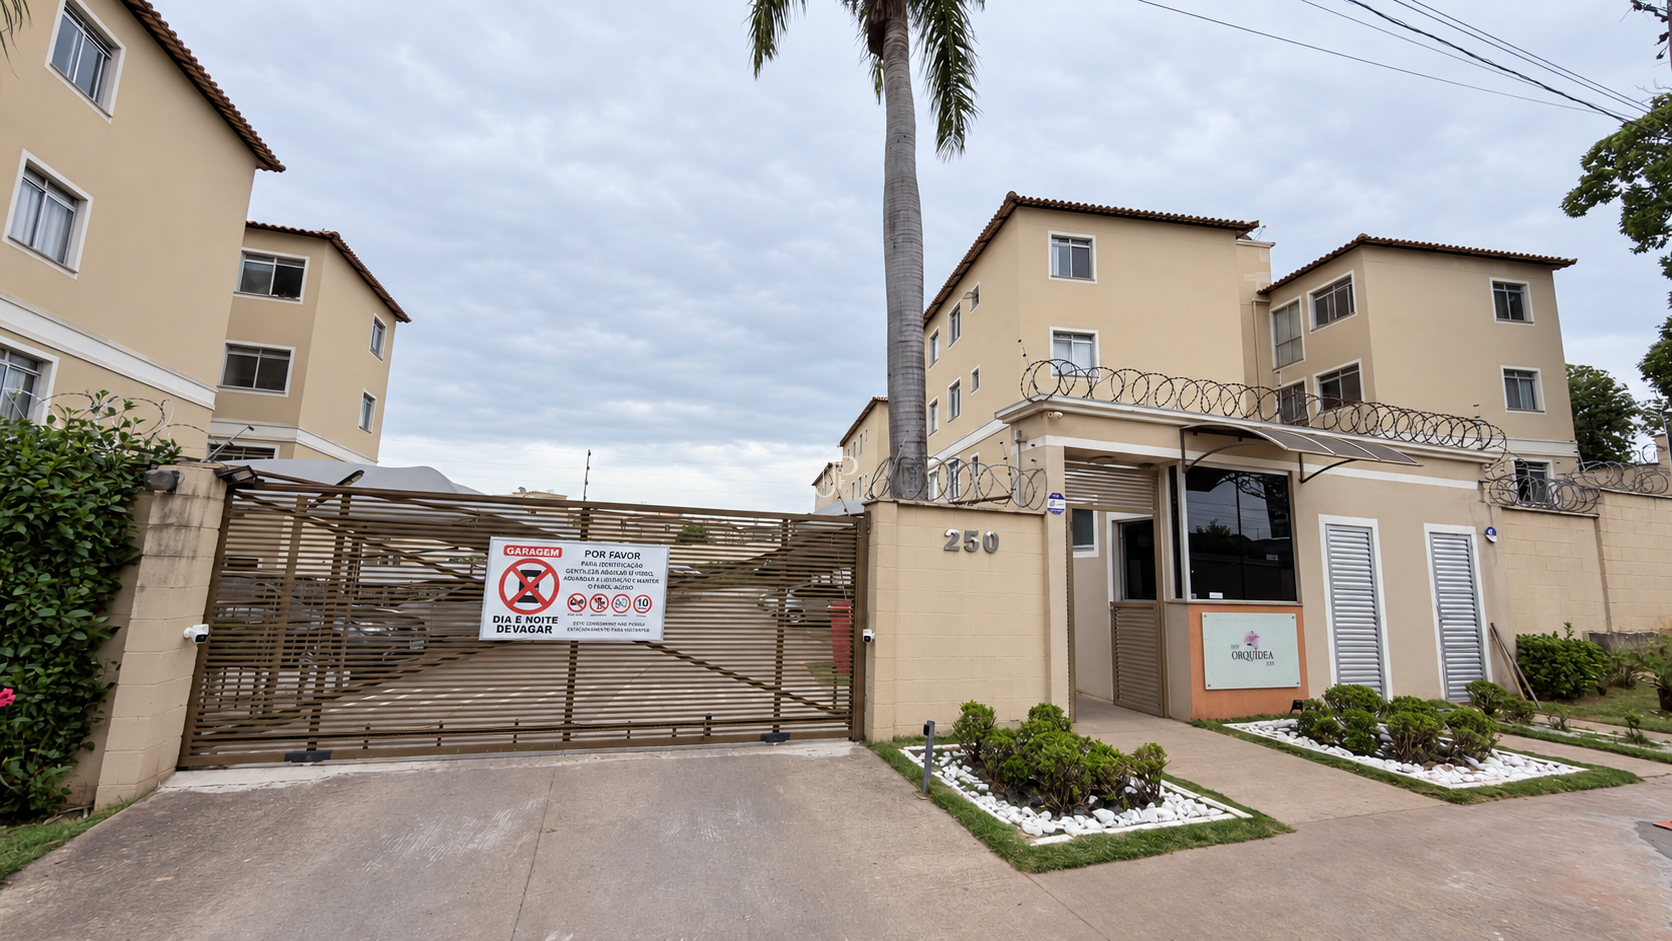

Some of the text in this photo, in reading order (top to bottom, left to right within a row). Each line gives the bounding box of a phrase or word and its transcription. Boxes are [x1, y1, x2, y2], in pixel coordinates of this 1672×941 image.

[944, 528, 1000, 553] 250
[506, 547, 560, 556] GARAGEM
[584, 550, 640, 560] POR FAVOR
[638, 598, 649, 607] 10
[525, 616, 558, 624] NOITE
[496, 625, 552, 634] DEVAGAR
